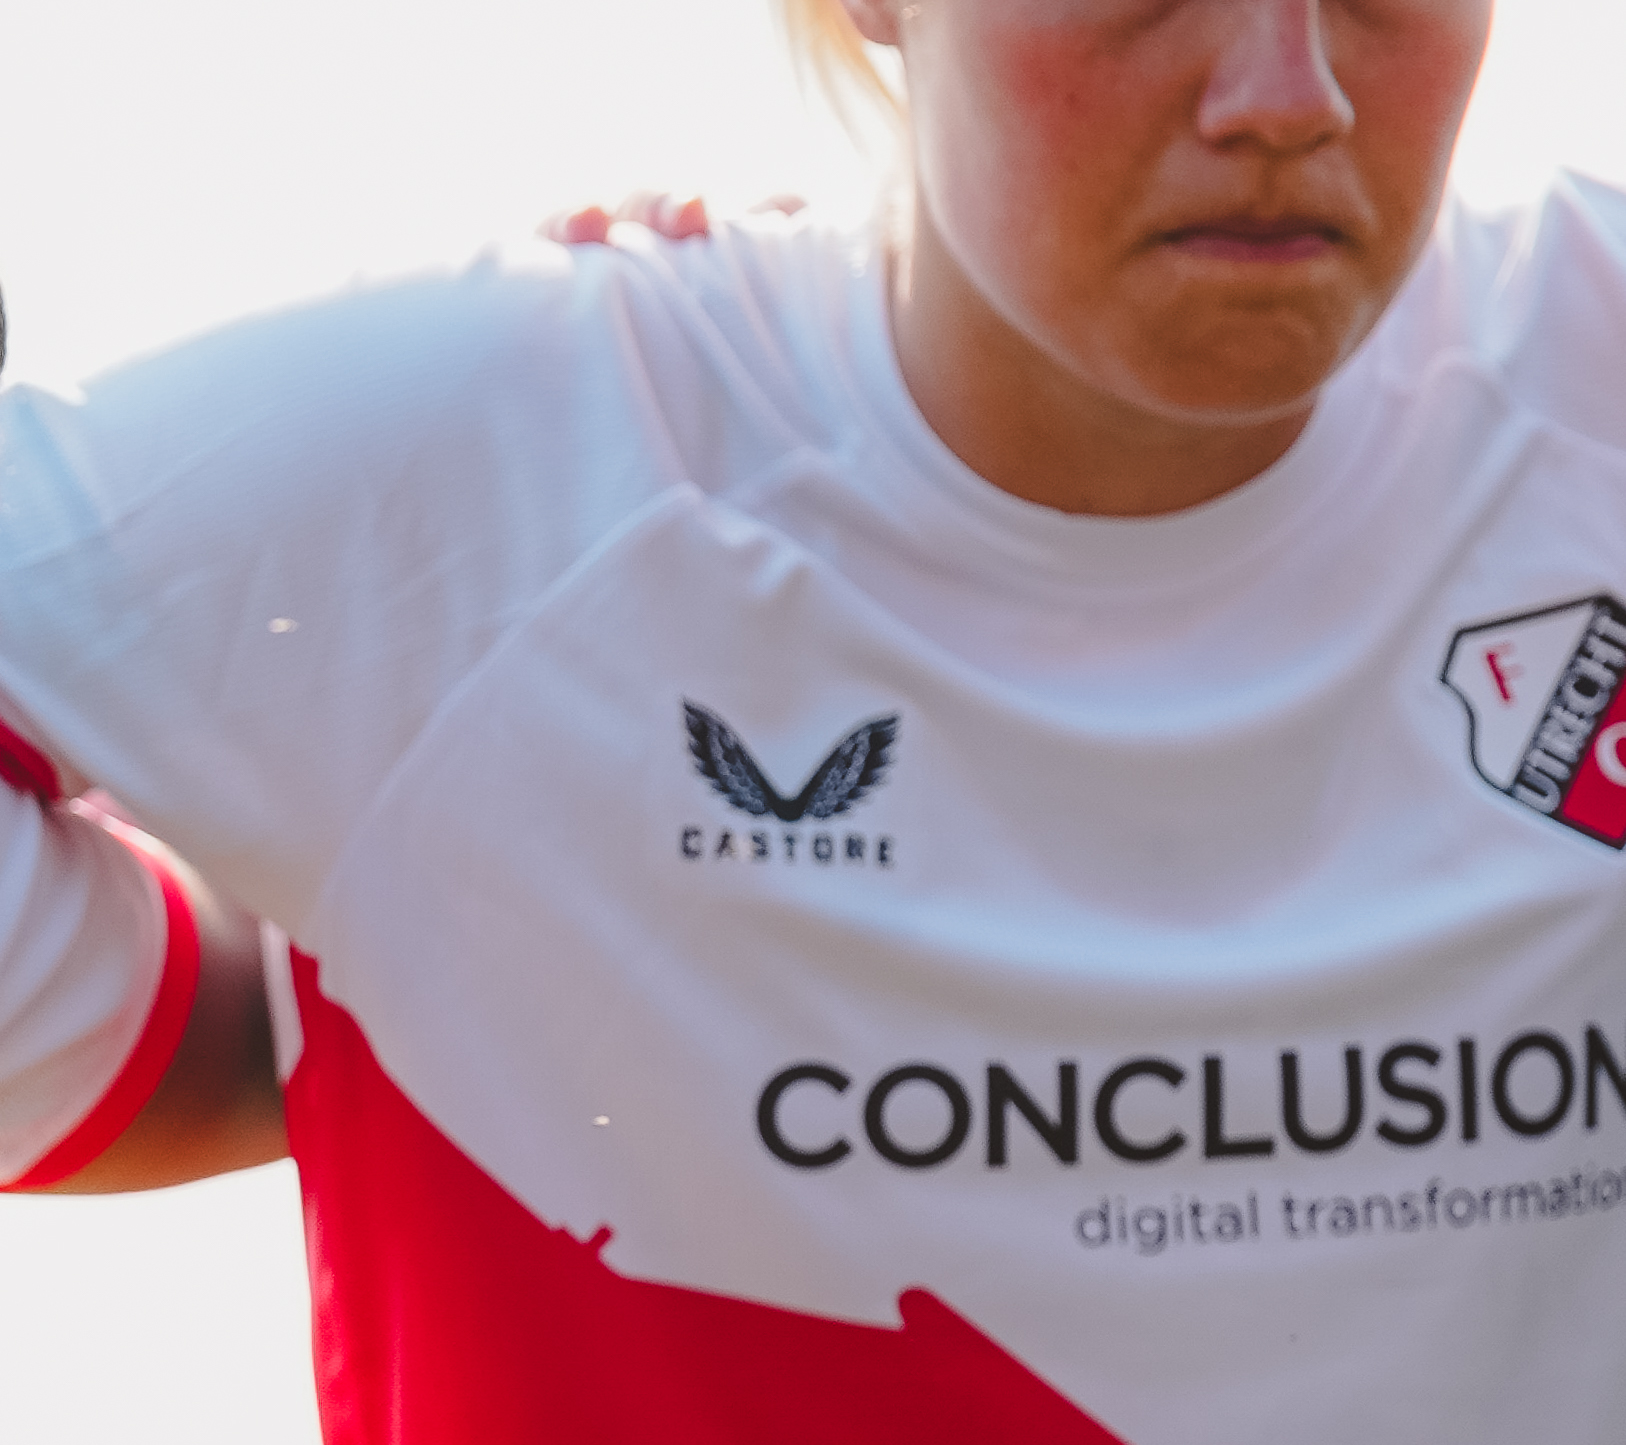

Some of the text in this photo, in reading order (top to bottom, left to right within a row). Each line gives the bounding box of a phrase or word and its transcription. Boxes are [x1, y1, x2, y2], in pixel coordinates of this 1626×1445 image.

[680, 821, 897, 870] CASTORE
[1074, 1166, 1626, 1258] digital transformatio
